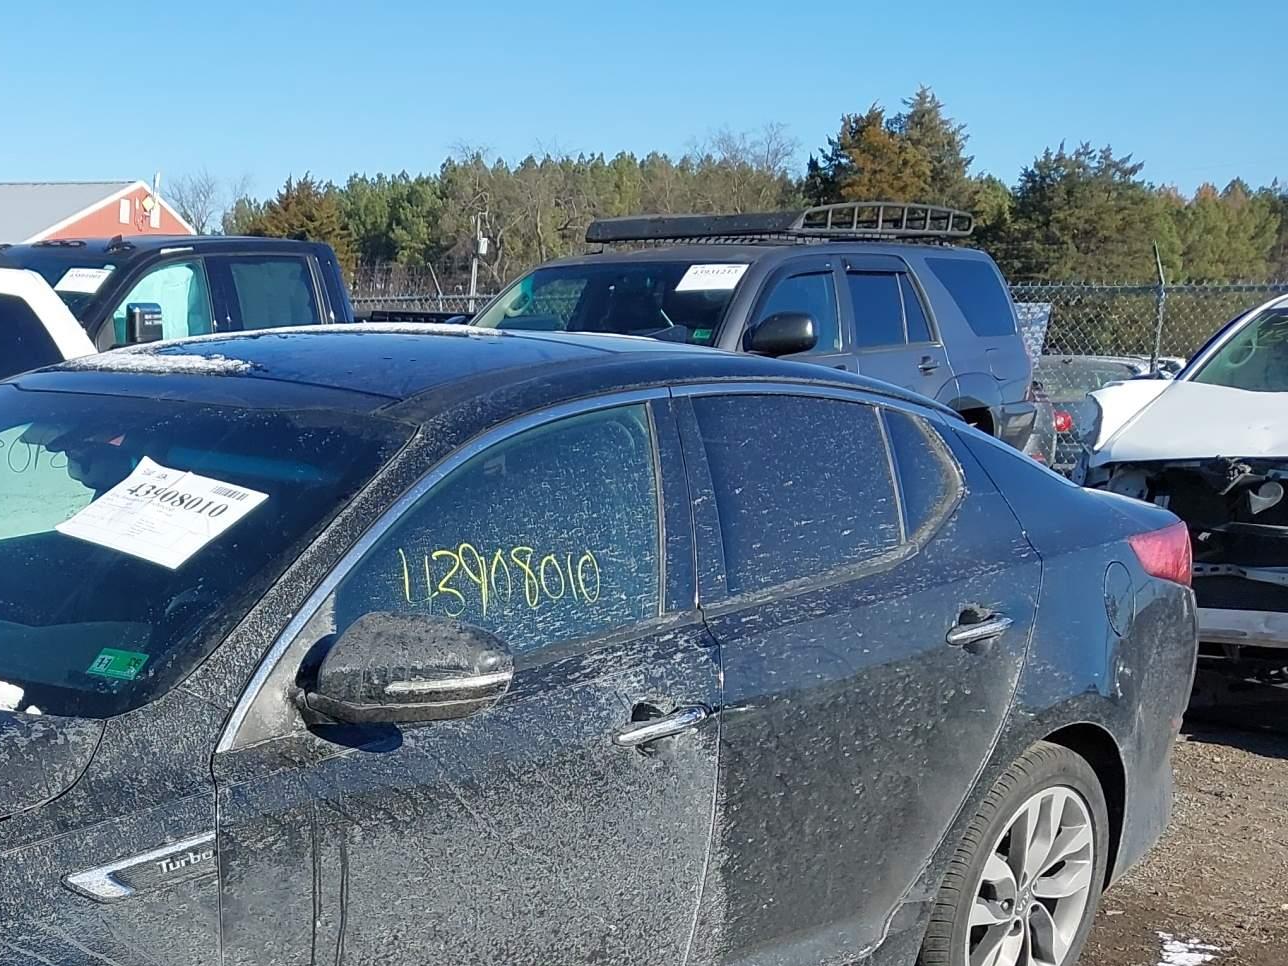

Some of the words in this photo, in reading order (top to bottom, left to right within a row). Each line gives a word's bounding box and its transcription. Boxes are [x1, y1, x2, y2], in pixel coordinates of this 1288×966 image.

[127, 482, 229, 518] 43908010
[398, 543, 600, 619] 43908010
[157, 849, 214, 873] Turbo
